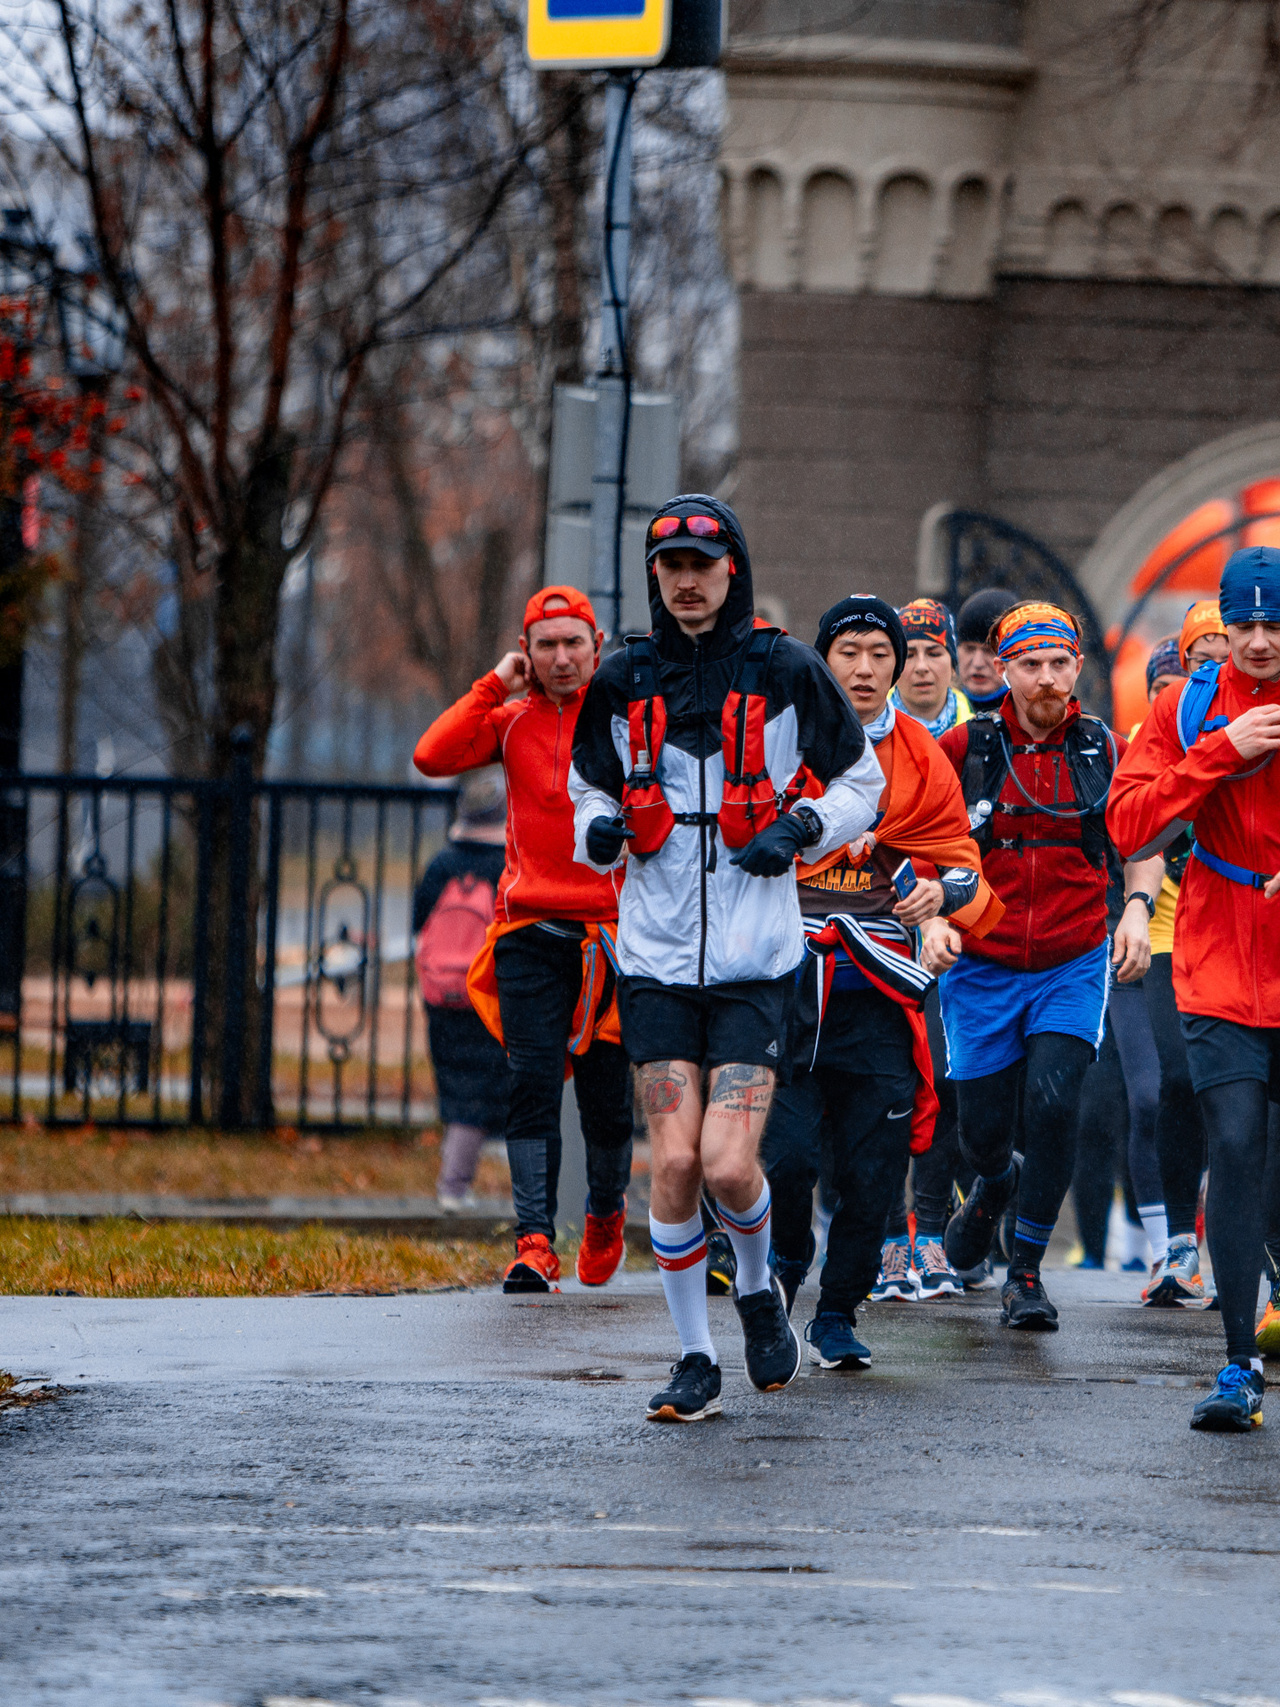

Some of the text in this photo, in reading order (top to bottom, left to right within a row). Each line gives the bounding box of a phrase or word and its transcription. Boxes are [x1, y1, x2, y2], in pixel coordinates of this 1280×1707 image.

[830, 612, 887, 635] Octagon Shop
[797, 868, 874, 893] АНДА
